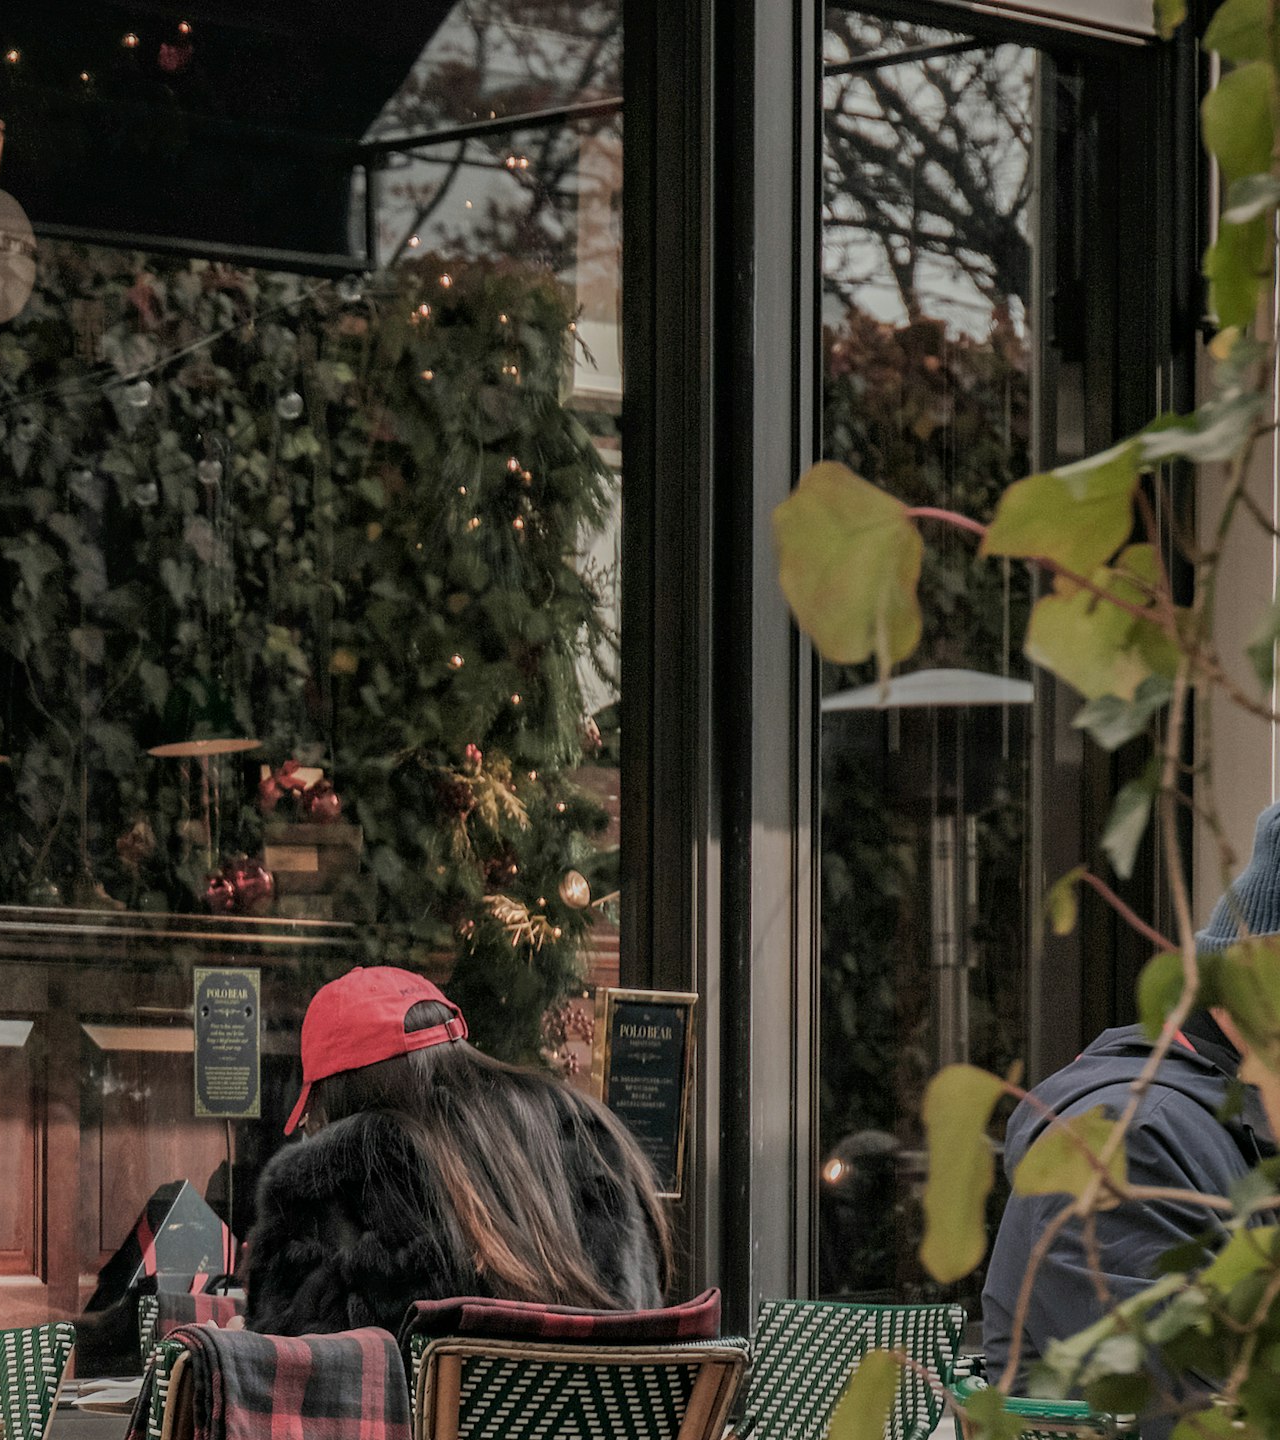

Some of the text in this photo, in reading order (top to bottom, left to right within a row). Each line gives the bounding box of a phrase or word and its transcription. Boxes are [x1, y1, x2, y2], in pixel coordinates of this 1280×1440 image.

[206, 988, 249, 1000] POLO BEAR
[620, 1024, 673, 1040] POLO BEAR
